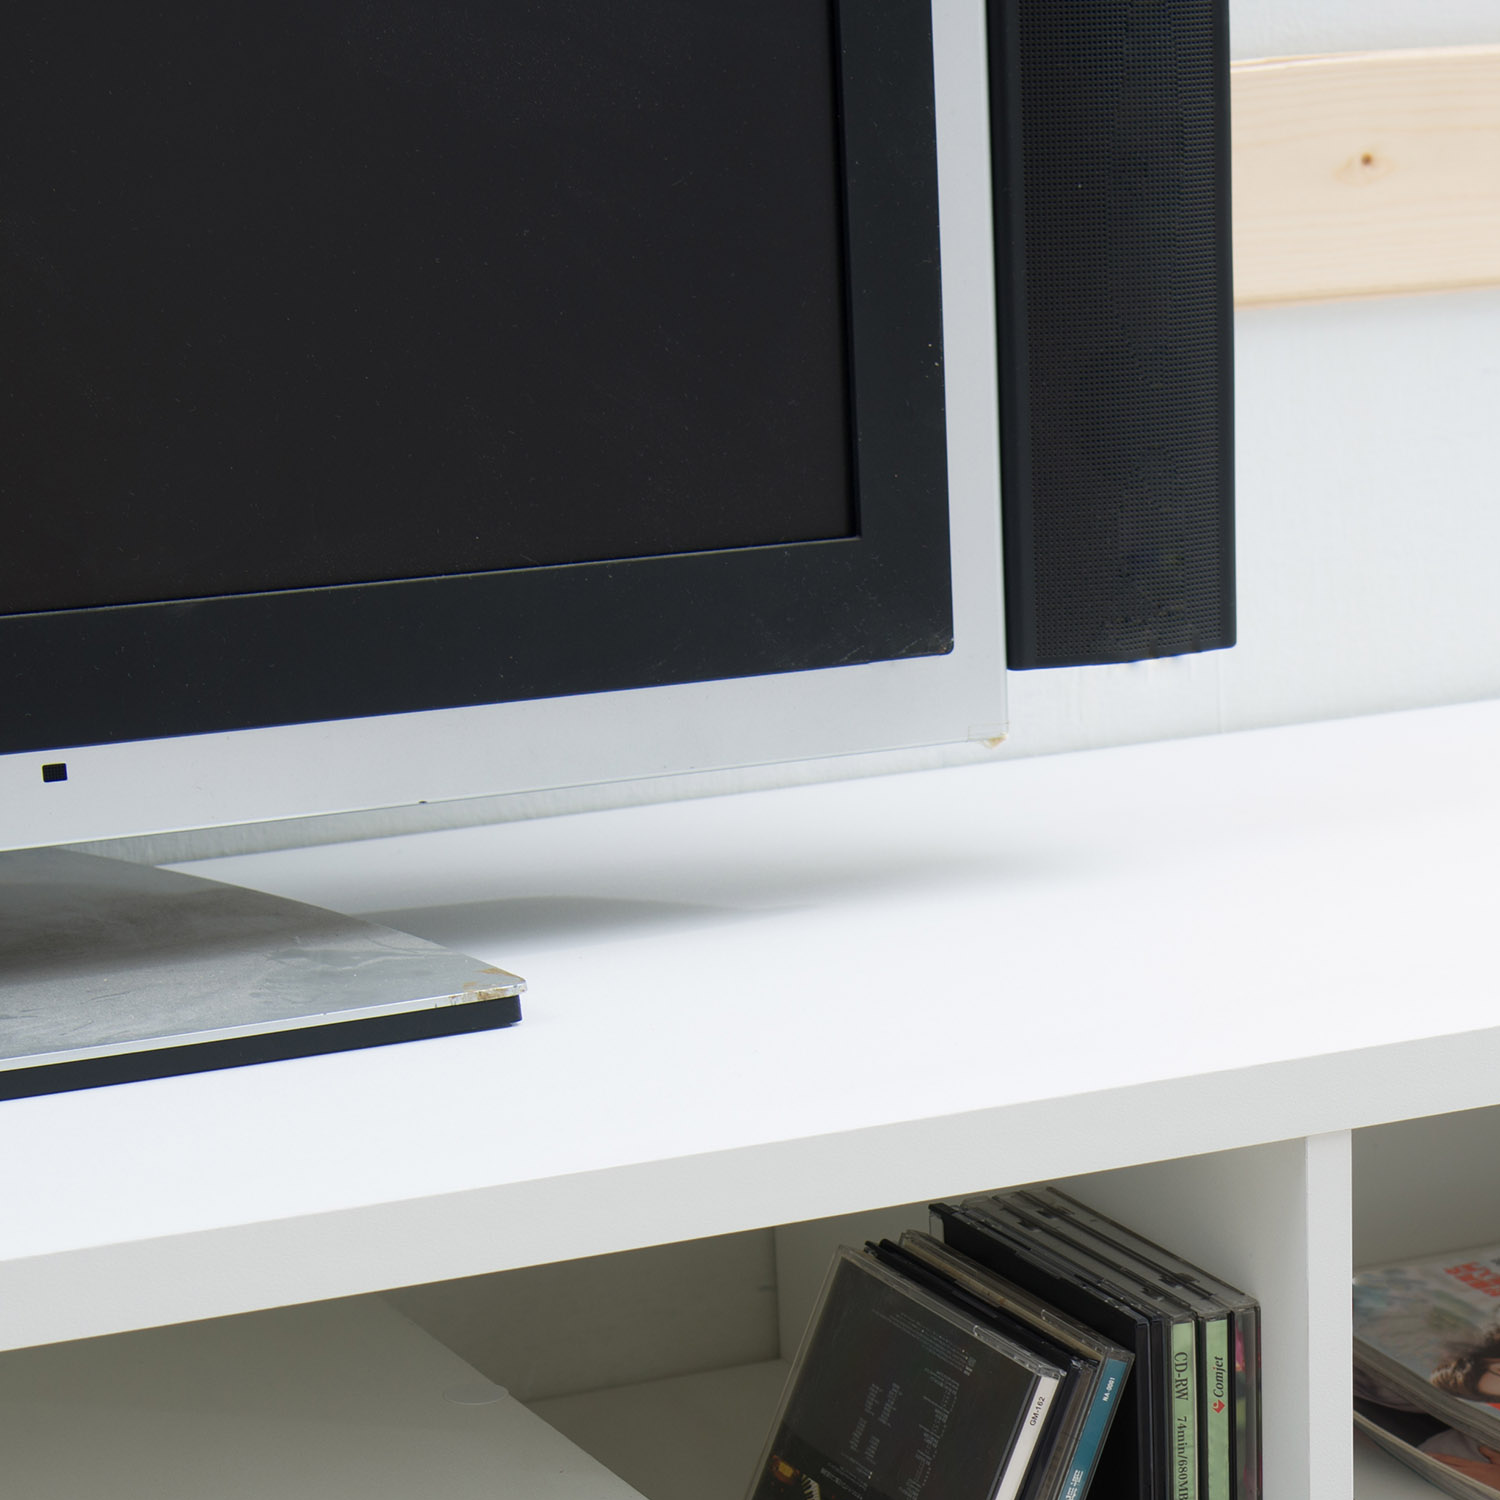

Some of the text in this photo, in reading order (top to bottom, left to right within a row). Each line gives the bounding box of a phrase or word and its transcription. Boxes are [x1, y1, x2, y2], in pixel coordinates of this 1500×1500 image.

[1212, 1356, 1226, 1398] Comjet
[1030, 1396, 1045, 1426] GM-162
[1174, 1352, 1188, 1500] CD-RW 74min/680MB
